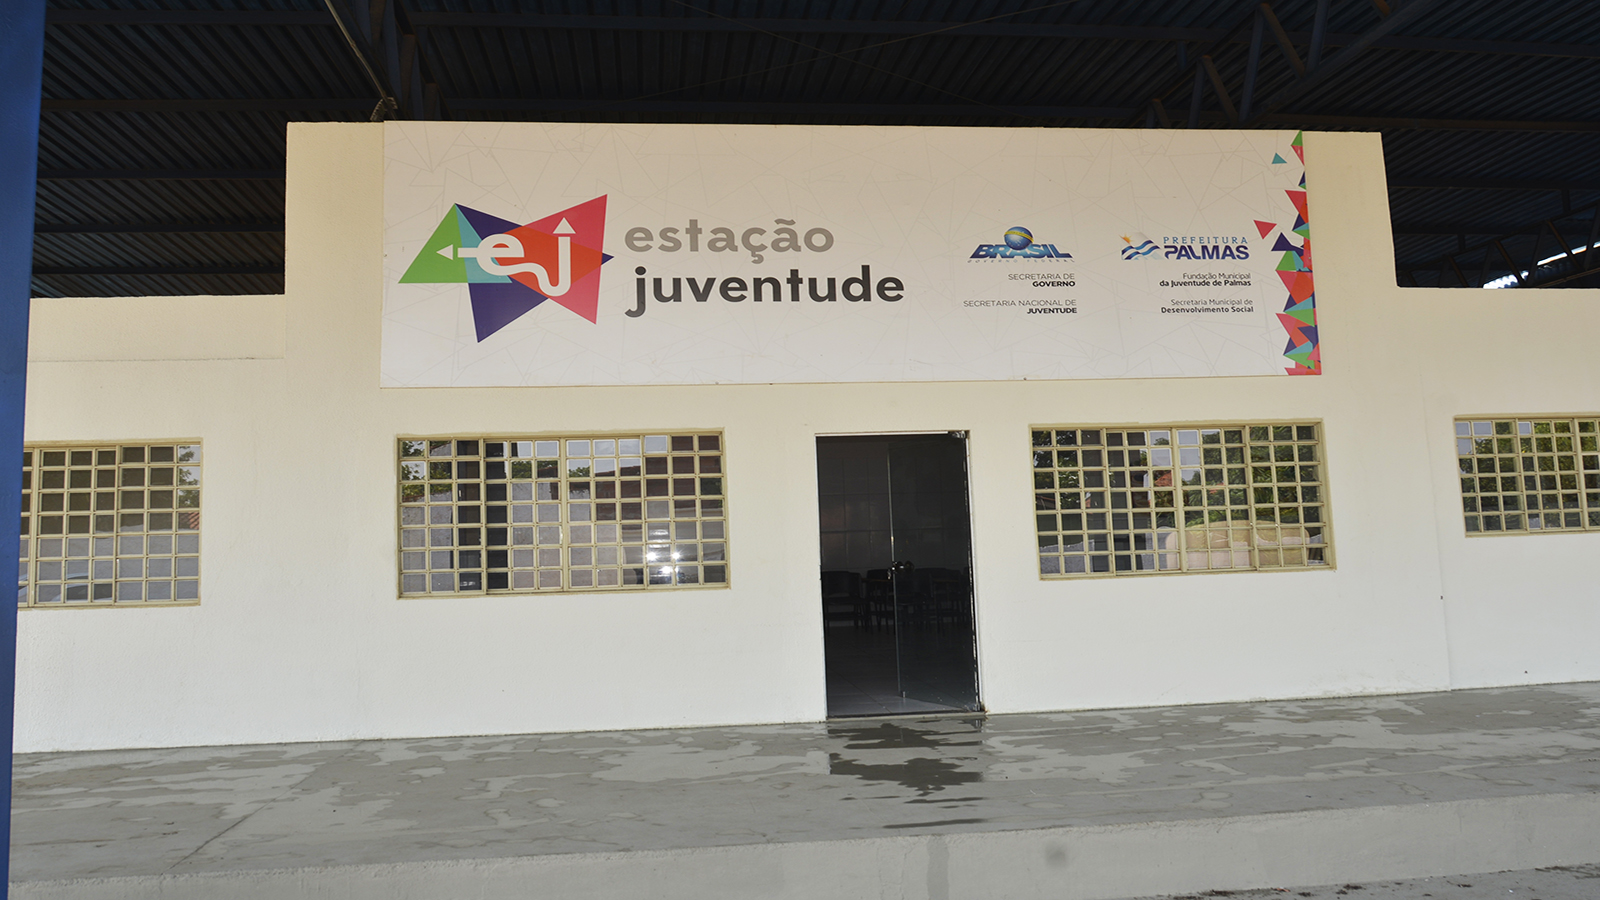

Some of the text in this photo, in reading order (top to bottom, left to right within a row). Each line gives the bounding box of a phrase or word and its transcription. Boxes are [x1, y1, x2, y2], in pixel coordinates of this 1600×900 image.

[624, 218, 834, 264] estação
[1163, 236, 1248, 244] PREFEITURA
[969, 244, 1073, 259] BRASIL
[1164, 245, 1250, 260] PALMAS
[1182, 272, 1251, 280] Fundação Municipal
[1171, 280, 1211, 288] Juventude
[625, 265, 905, 318] juventude
[1018, 299, 1063, 307] NACIONAL
[1209, 298, 1242, 306] Municipal
